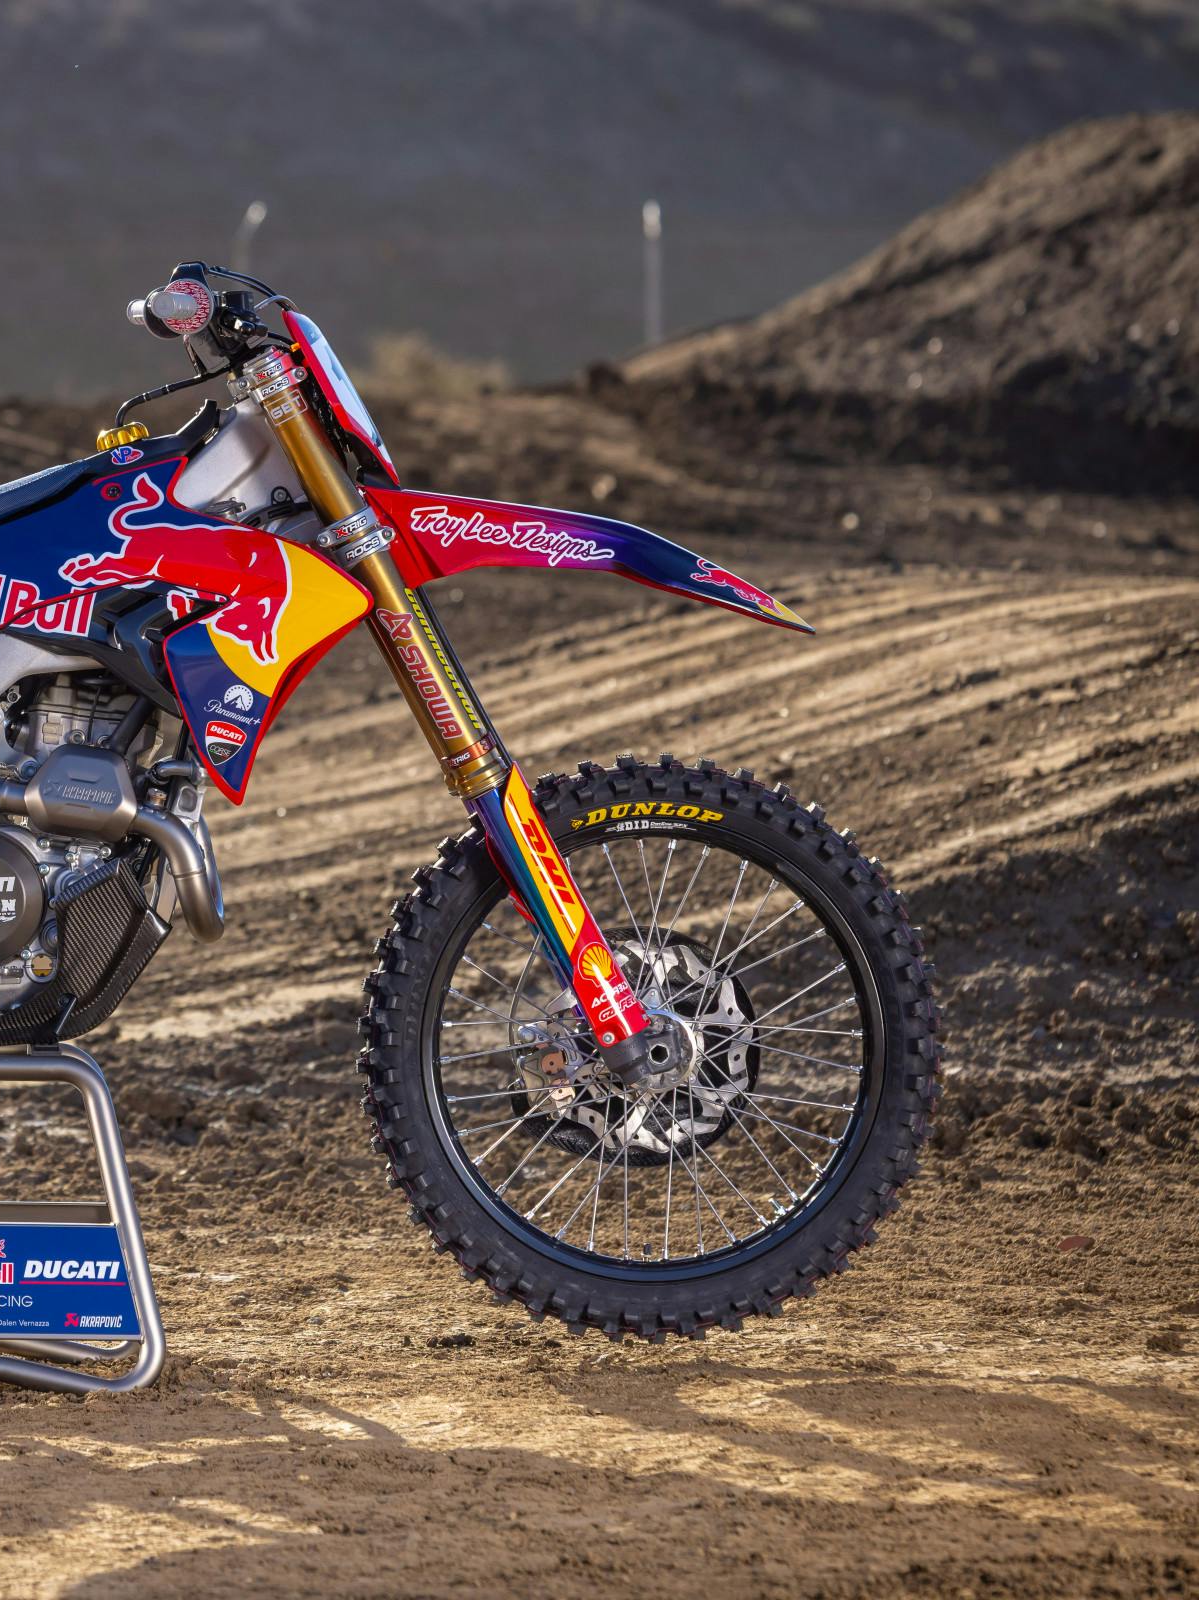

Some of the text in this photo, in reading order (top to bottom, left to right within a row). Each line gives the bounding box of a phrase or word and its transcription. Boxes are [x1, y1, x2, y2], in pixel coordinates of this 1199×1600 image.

[256, 362, 282, 380] XTRIG
[262, 376, 290, 397] ROCS
[111, 446, 133, 464] VP
[332, 516, 368, 540] XTRIG
[411, 506, 615, 567] Troy Lee Designs
[345, 536, 380, 561] ROCS
[0, 579, 97, 638] Bull
[397, 644, 463, 740] SHOWA
[203, 699, 262, 726] Paramount+
[210, 725, 244, 742] DUCATI
[209, 744, 232, 757] CORSE
[585, 802, 724, 827] DUNLOP
[24, 1260, 120, 1279] DUCATI
[19, 1319, 50, 1327] Vernazza
